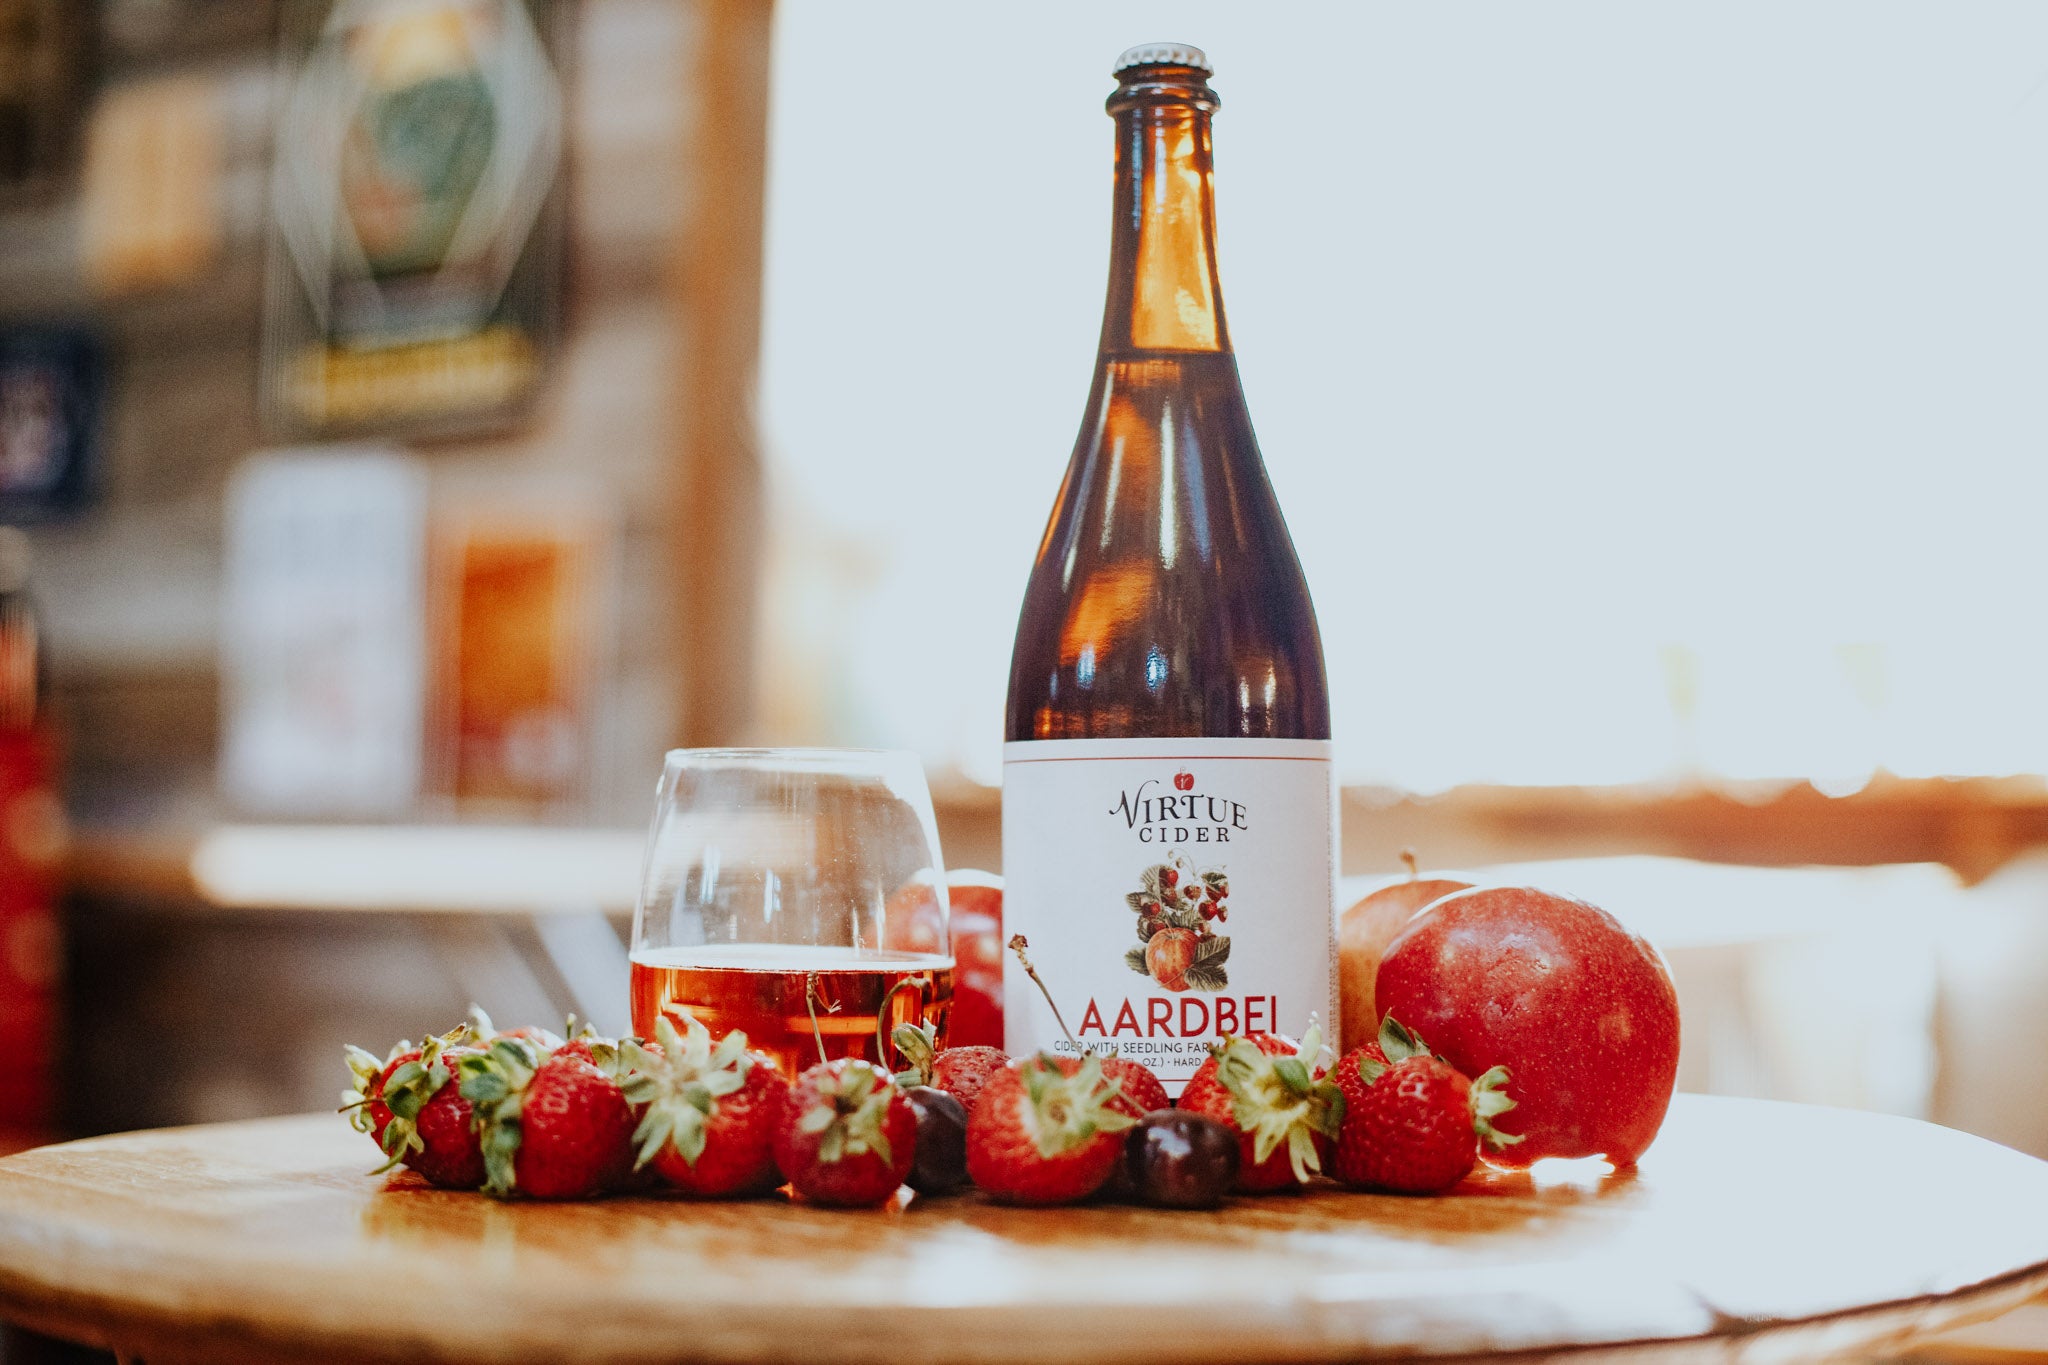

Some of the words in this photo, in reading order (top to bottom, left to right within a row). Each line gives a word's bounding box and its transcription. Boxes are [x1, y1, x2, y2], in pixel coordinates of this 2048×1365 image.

[1109, 779, 1248, 831] VIRTUE
[1139, 827, 1231, 843] CIDER
[1078, 995, 1277, 1037] AARDBEI
[1087, 1041, 1119, 1053] WITH
[1123, 1042, 1183, 1054] SEEDLING
[1187, 1042, 1220, 1054] FAR
[1173, 1057, 1202, 1067] HARD
